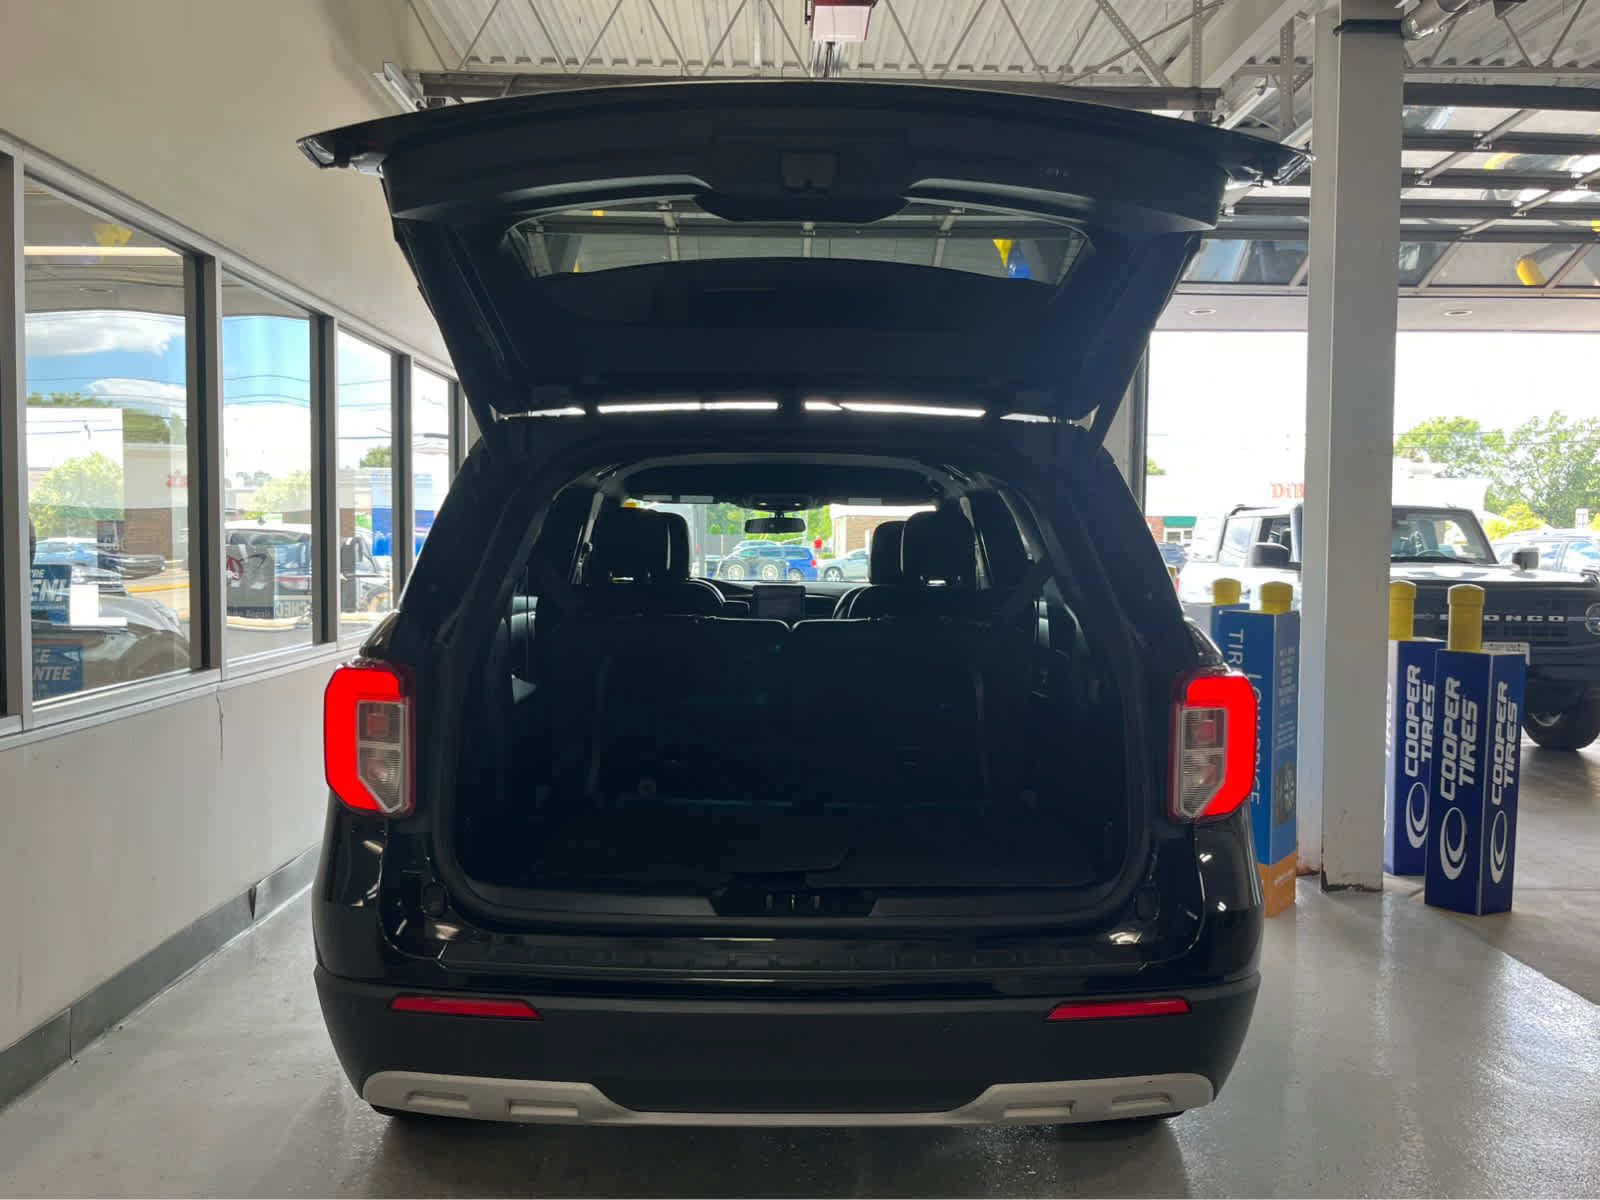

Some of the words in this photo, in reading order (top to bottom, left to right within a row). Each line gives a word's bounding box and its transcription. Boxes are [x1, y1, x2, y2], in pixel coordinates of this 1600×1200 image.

[1228, 627, 1244, 664] TIR
[1405, 664, 1421, 777] COOPER
[1421, 683, 1435, 762] TIRES
[1440, 677, 1461, 801] COOPER
[1458, 699, 1478, 786] TIRES
[1491, 681, 1508, 806] COOPER
[1503, 701, 1518, 788] TIRES
